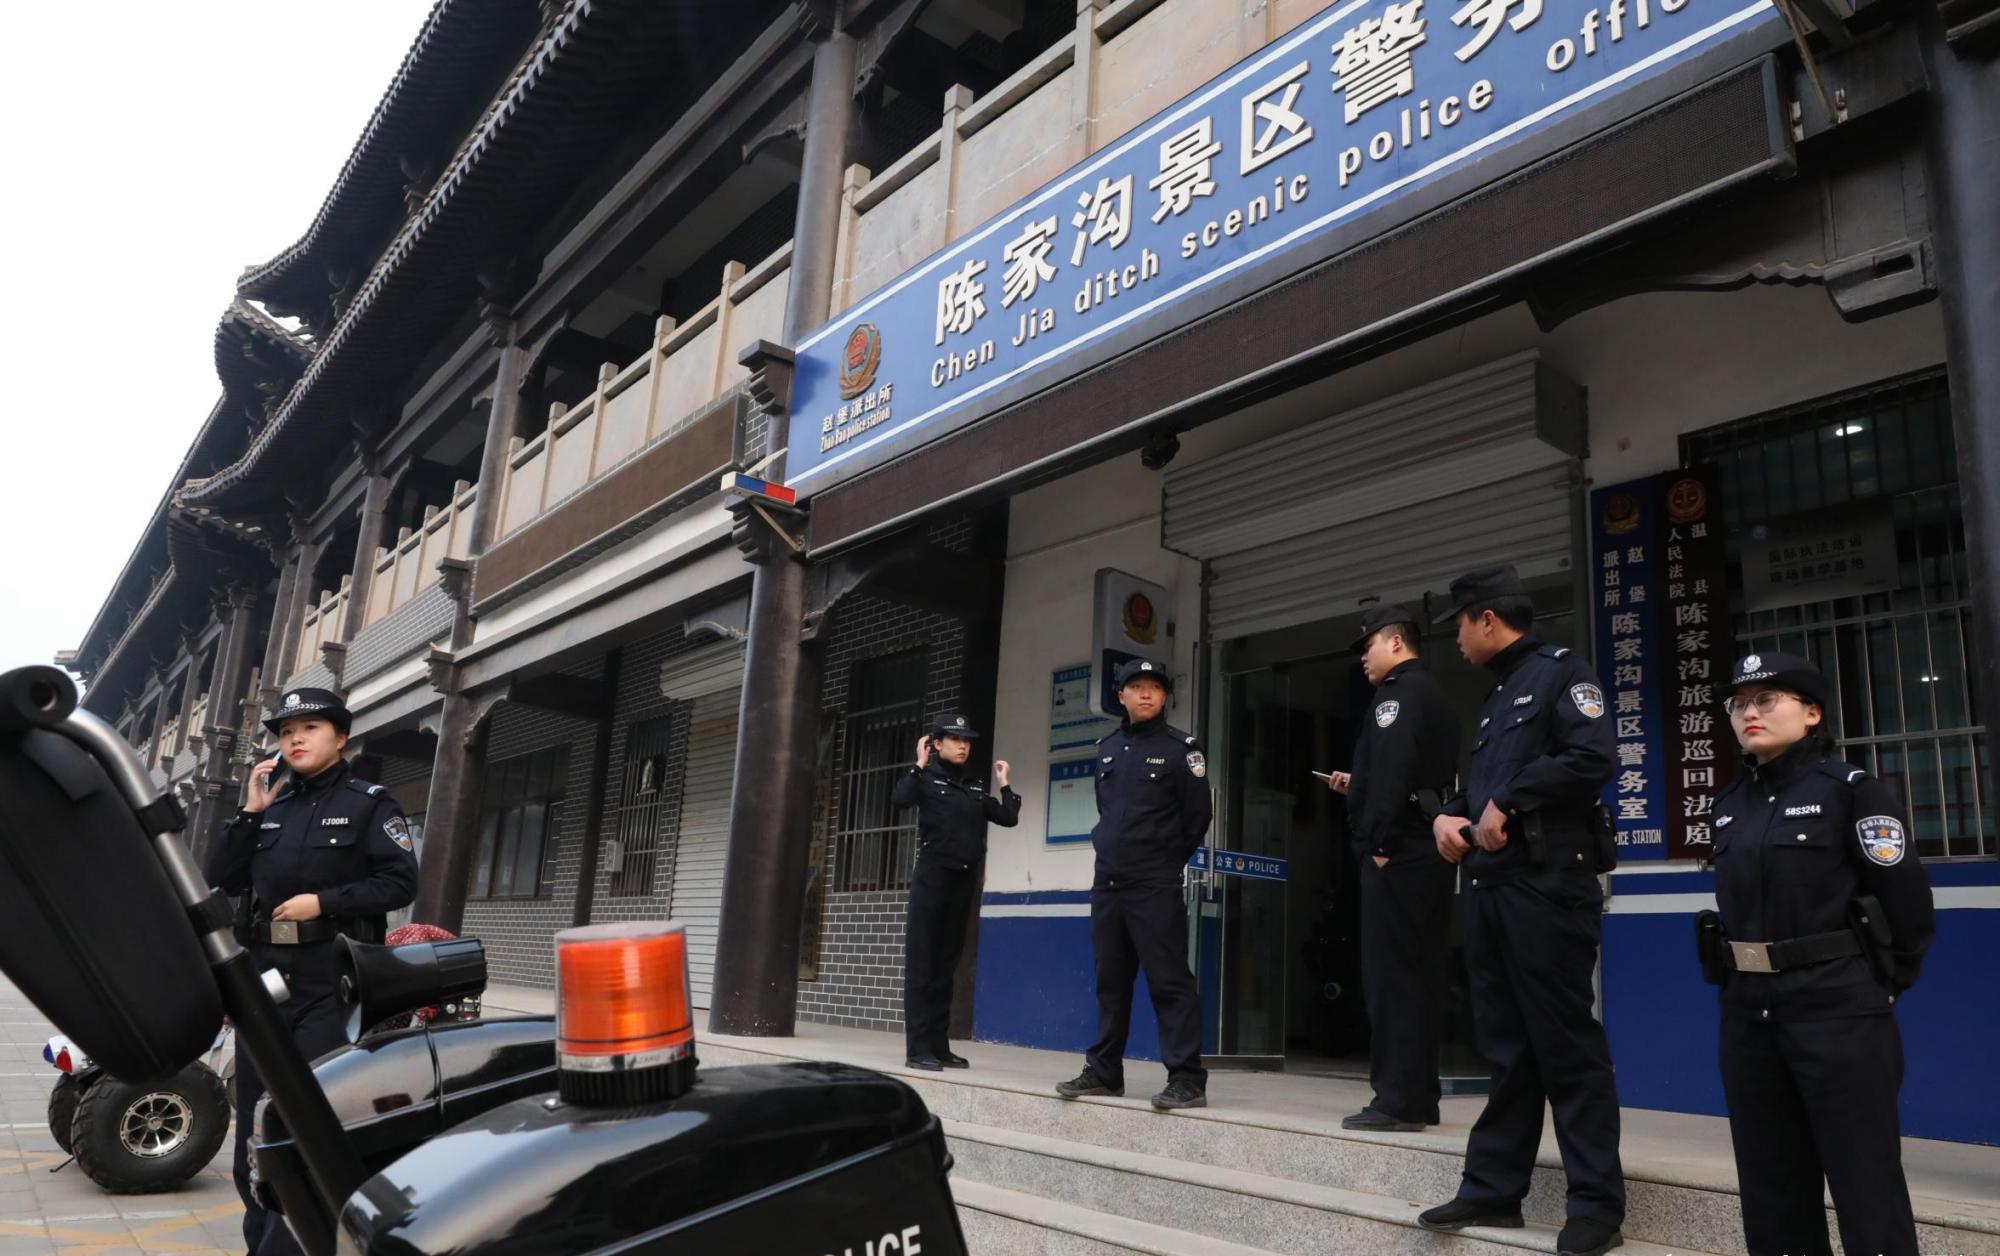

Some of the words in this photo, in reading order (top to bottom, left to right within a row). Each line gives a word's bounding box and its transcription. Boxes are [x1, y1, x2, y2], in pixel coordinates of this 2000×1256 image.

[931, 339, 995, 388] Chen
[1012, 306, 1055, 347] Jia
[1074, 248, 1160, 313] ditch
[1181, 173, 1309, 258] scenic
[1339, 78, 1494, 186] police
[823, 382, 893, 433] 赵堡派出所
[1603, 550, 1621, 607] 派出所
[1667, 527, 1686, 599] 人民法院
[1612, 612, 1649, 820] 陈家沟景区警务室
[1675, 602, 1715, 846] 陈家沟旅游巡回法庭
[1249, 860, 1280, 874] POLICE
[1632, 829, 1662, 845] STATION
